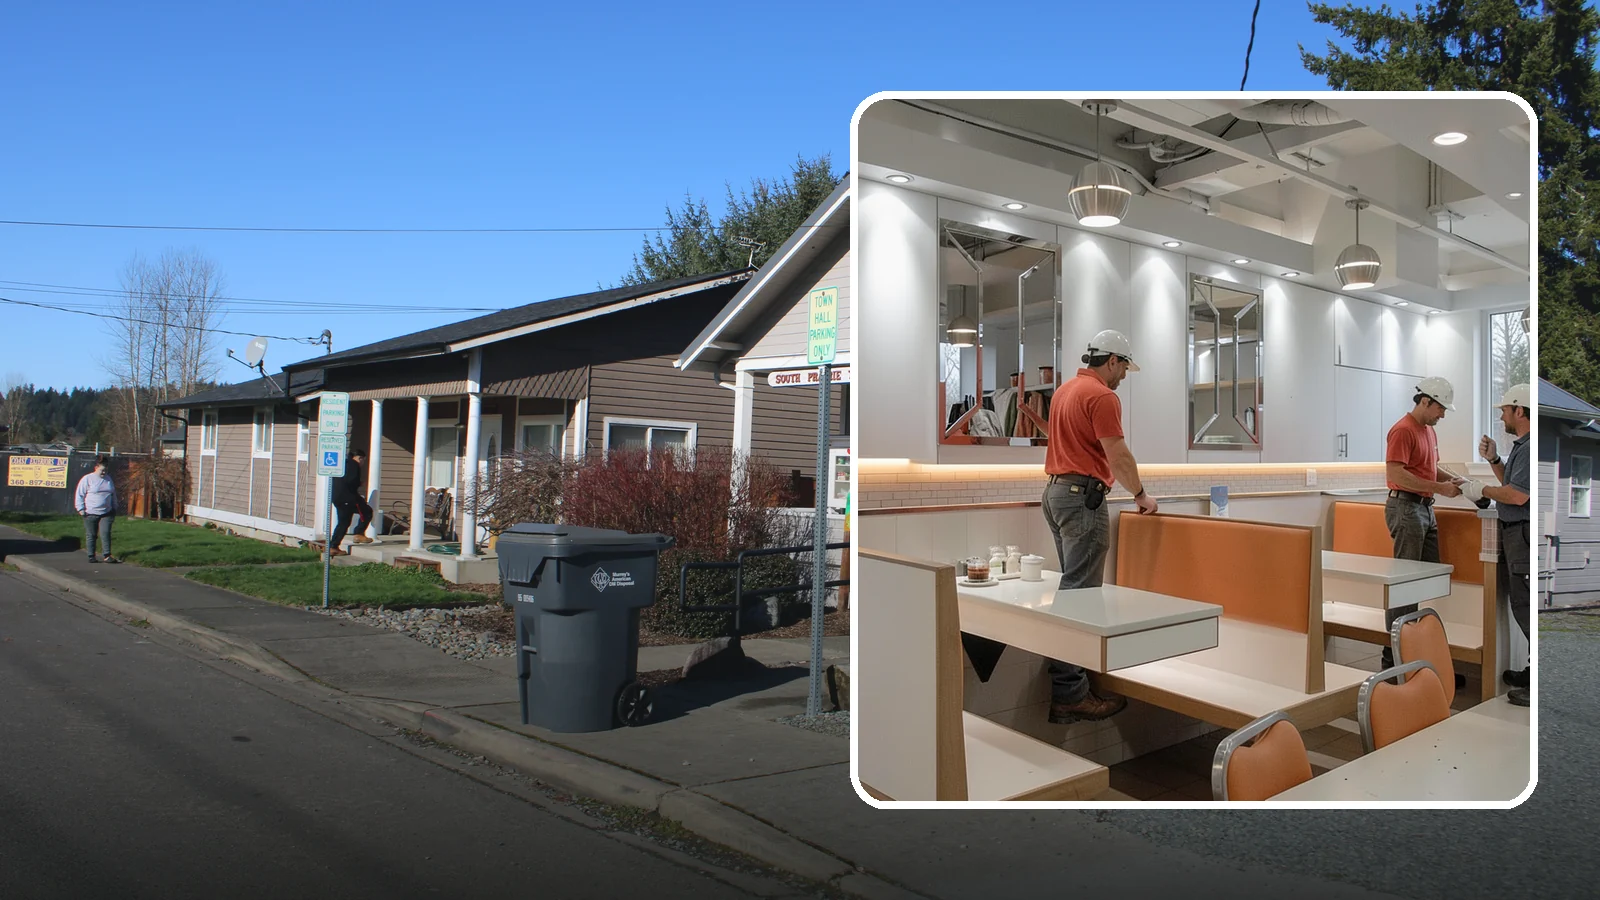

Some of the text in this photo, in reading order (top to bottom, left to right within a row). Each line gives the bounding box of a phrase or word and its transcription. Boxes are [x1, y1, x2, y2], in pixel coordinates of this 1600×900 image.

[815, 295, 833, 308] TOWN
[814, 311, 832, 325] HALL
[809, 326, 836, 341] PARKING
[813, 344, 831, 357] ONLY
[775, 373, 801, 384] SOUTH
[320, 436, 344, 444] RESERVED
